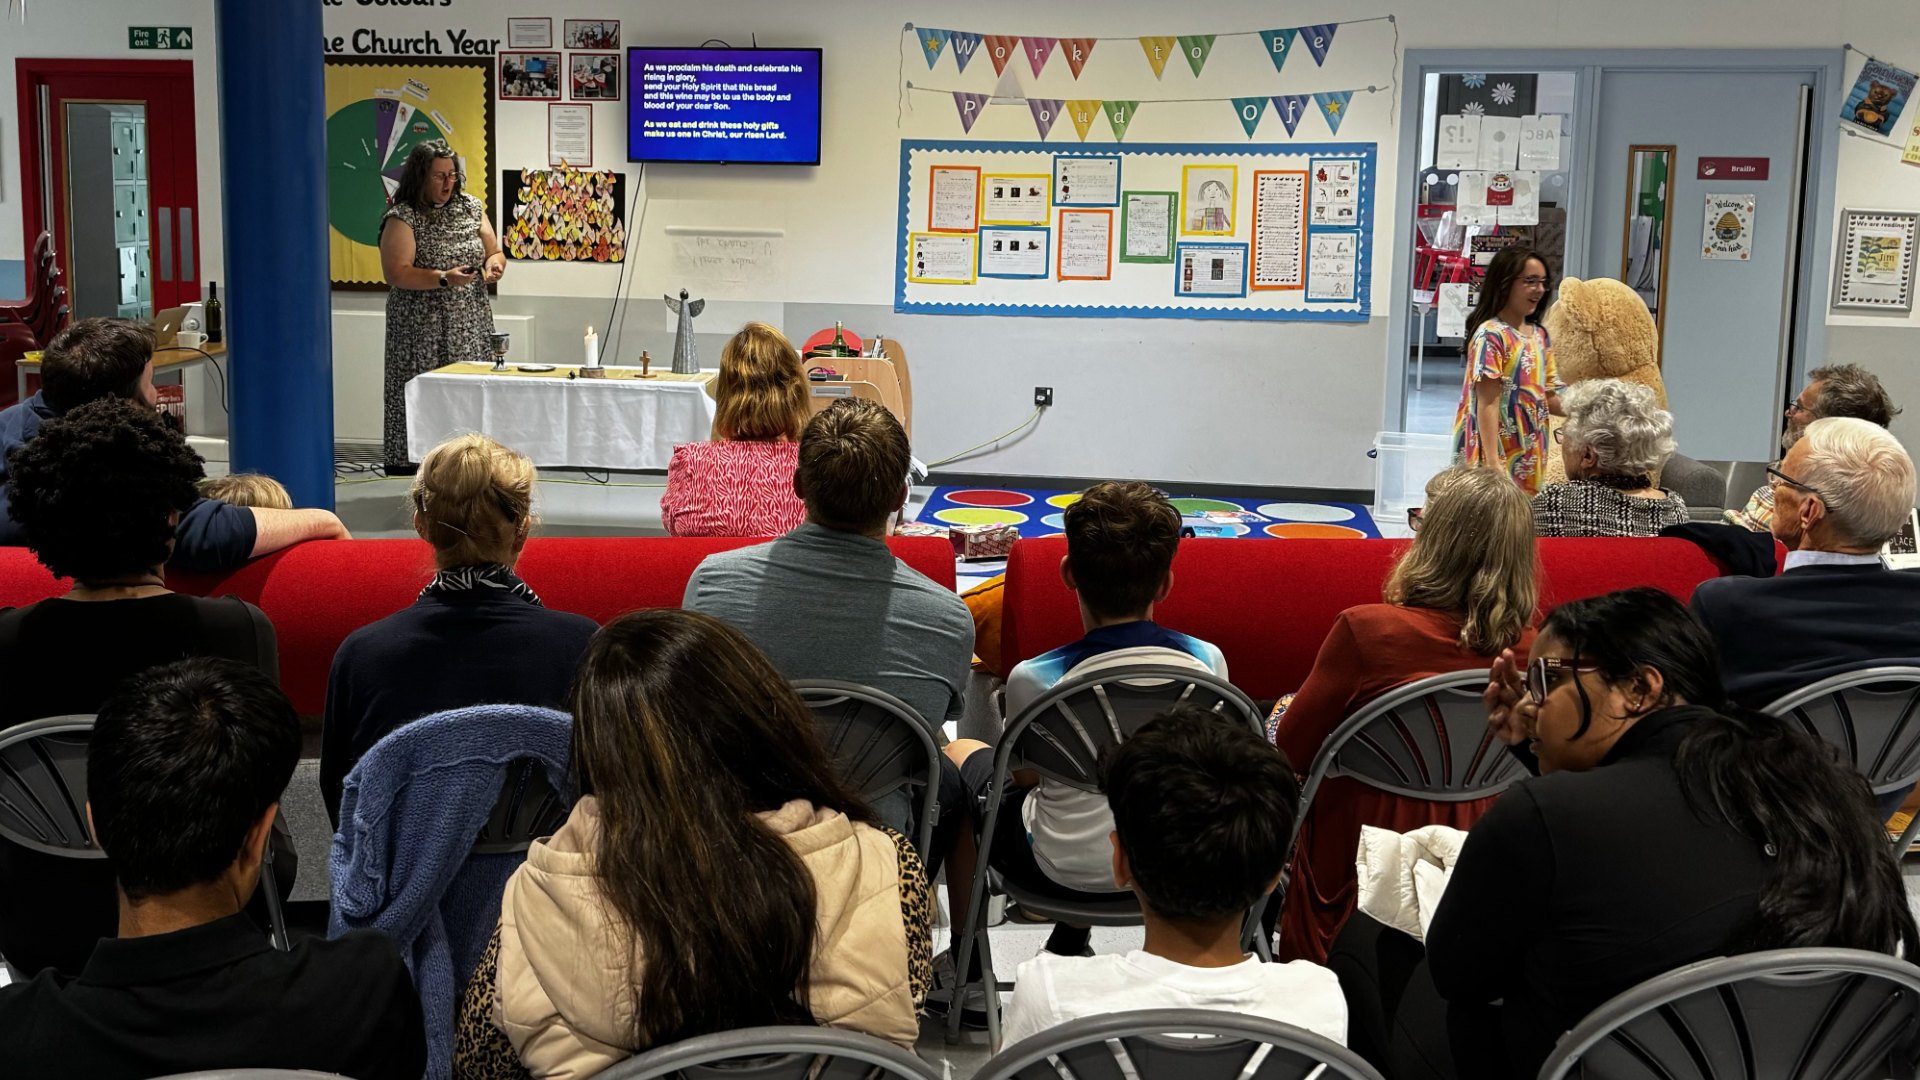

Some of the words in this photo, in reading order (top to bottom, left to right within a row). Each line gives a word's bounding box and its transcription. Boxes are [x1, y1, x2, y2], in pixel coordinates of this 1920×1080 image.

[352, 28, 442, 54] Church
[446, 29, 500, 54] Year
[955, 39, 1083, 62] Work
[1154, 46, 1201, 60] to
[1273, 36, 1324, 52] Be
[668, 64, 701, 73] proclaim
[644, 73, 665, 82] rising
[675, 73, 696, 82] glory,
[682, 83, 699, 92] Holy
[700, 83, 721, 92] Spirit
[756, 93, 775, 102] body
[964, 100, 1125, 124] Poud
[1242, 100, 1296, 123] Of
[743, 122, 760, 130] holy
[761, 122, 779, 130] gifts
[702, 130, 728, 139] Christ,
[1715, 200, 1744, 210] Welcome
[1879, 253, 1895, 262] Jim
[1890, 536, 1914, 547] PLACE
